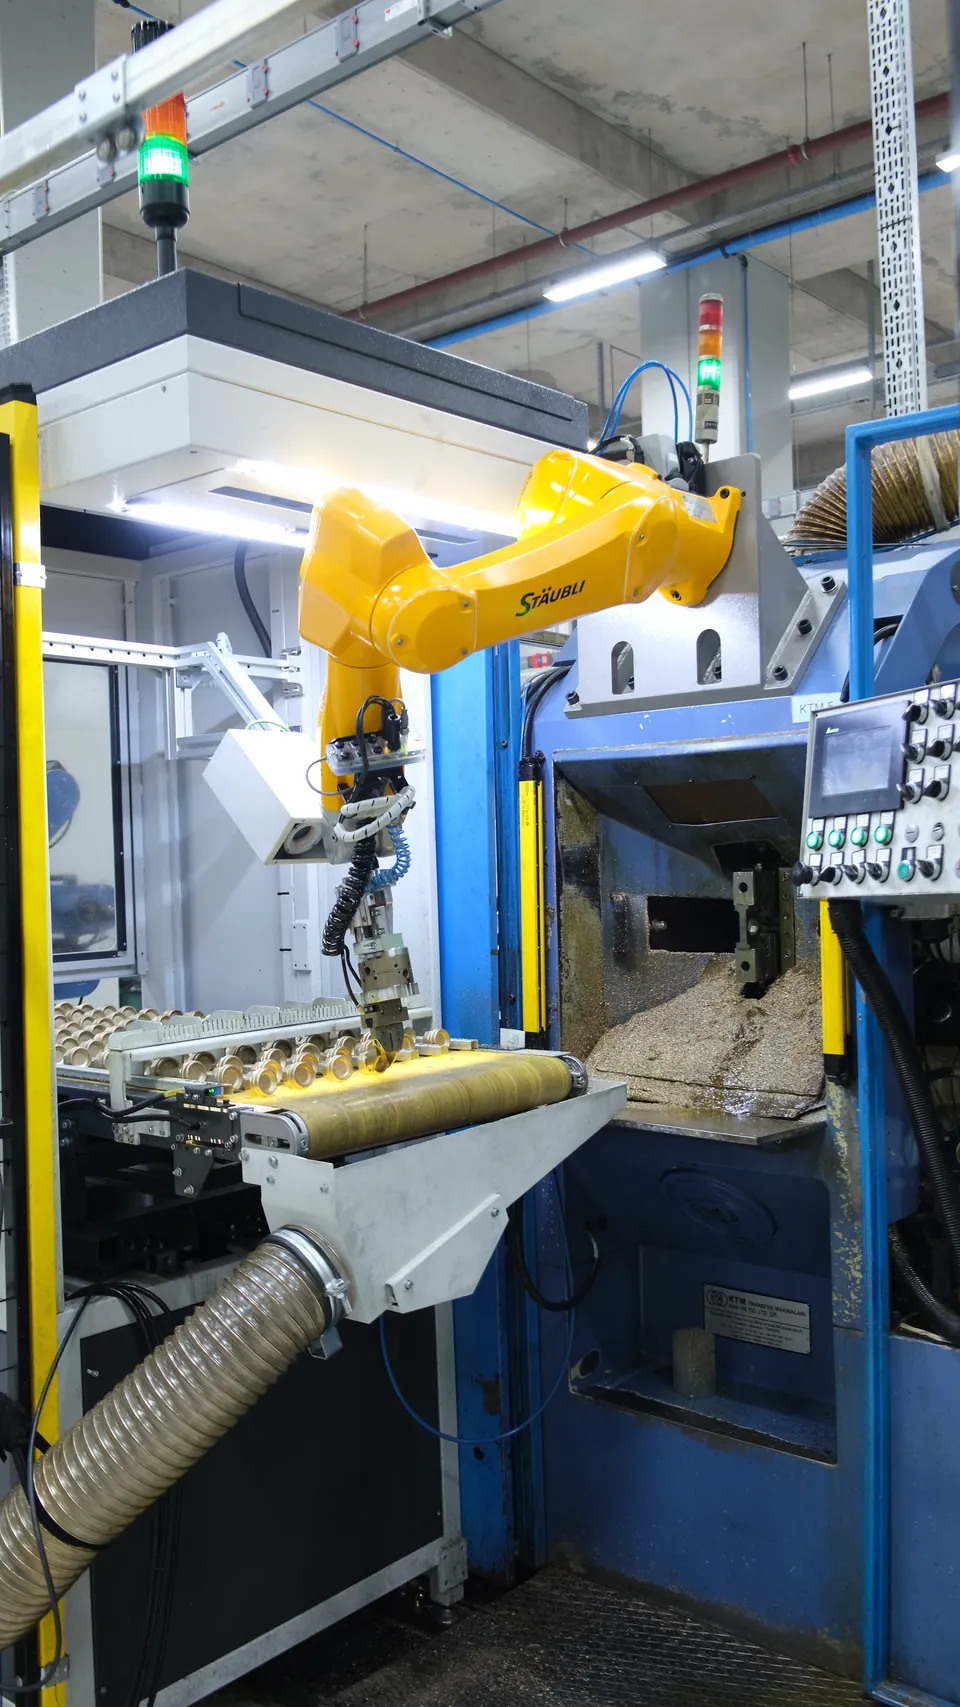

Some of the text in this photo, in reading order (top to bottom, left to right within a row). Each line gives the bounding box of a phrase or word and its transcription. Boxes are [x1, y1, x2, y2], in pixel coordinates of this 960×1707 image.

[515, 580, 586, 617] STÄUBLI
[799, 702, 824, 714] KTM
[728, 1295, 746, 1305] KTM
